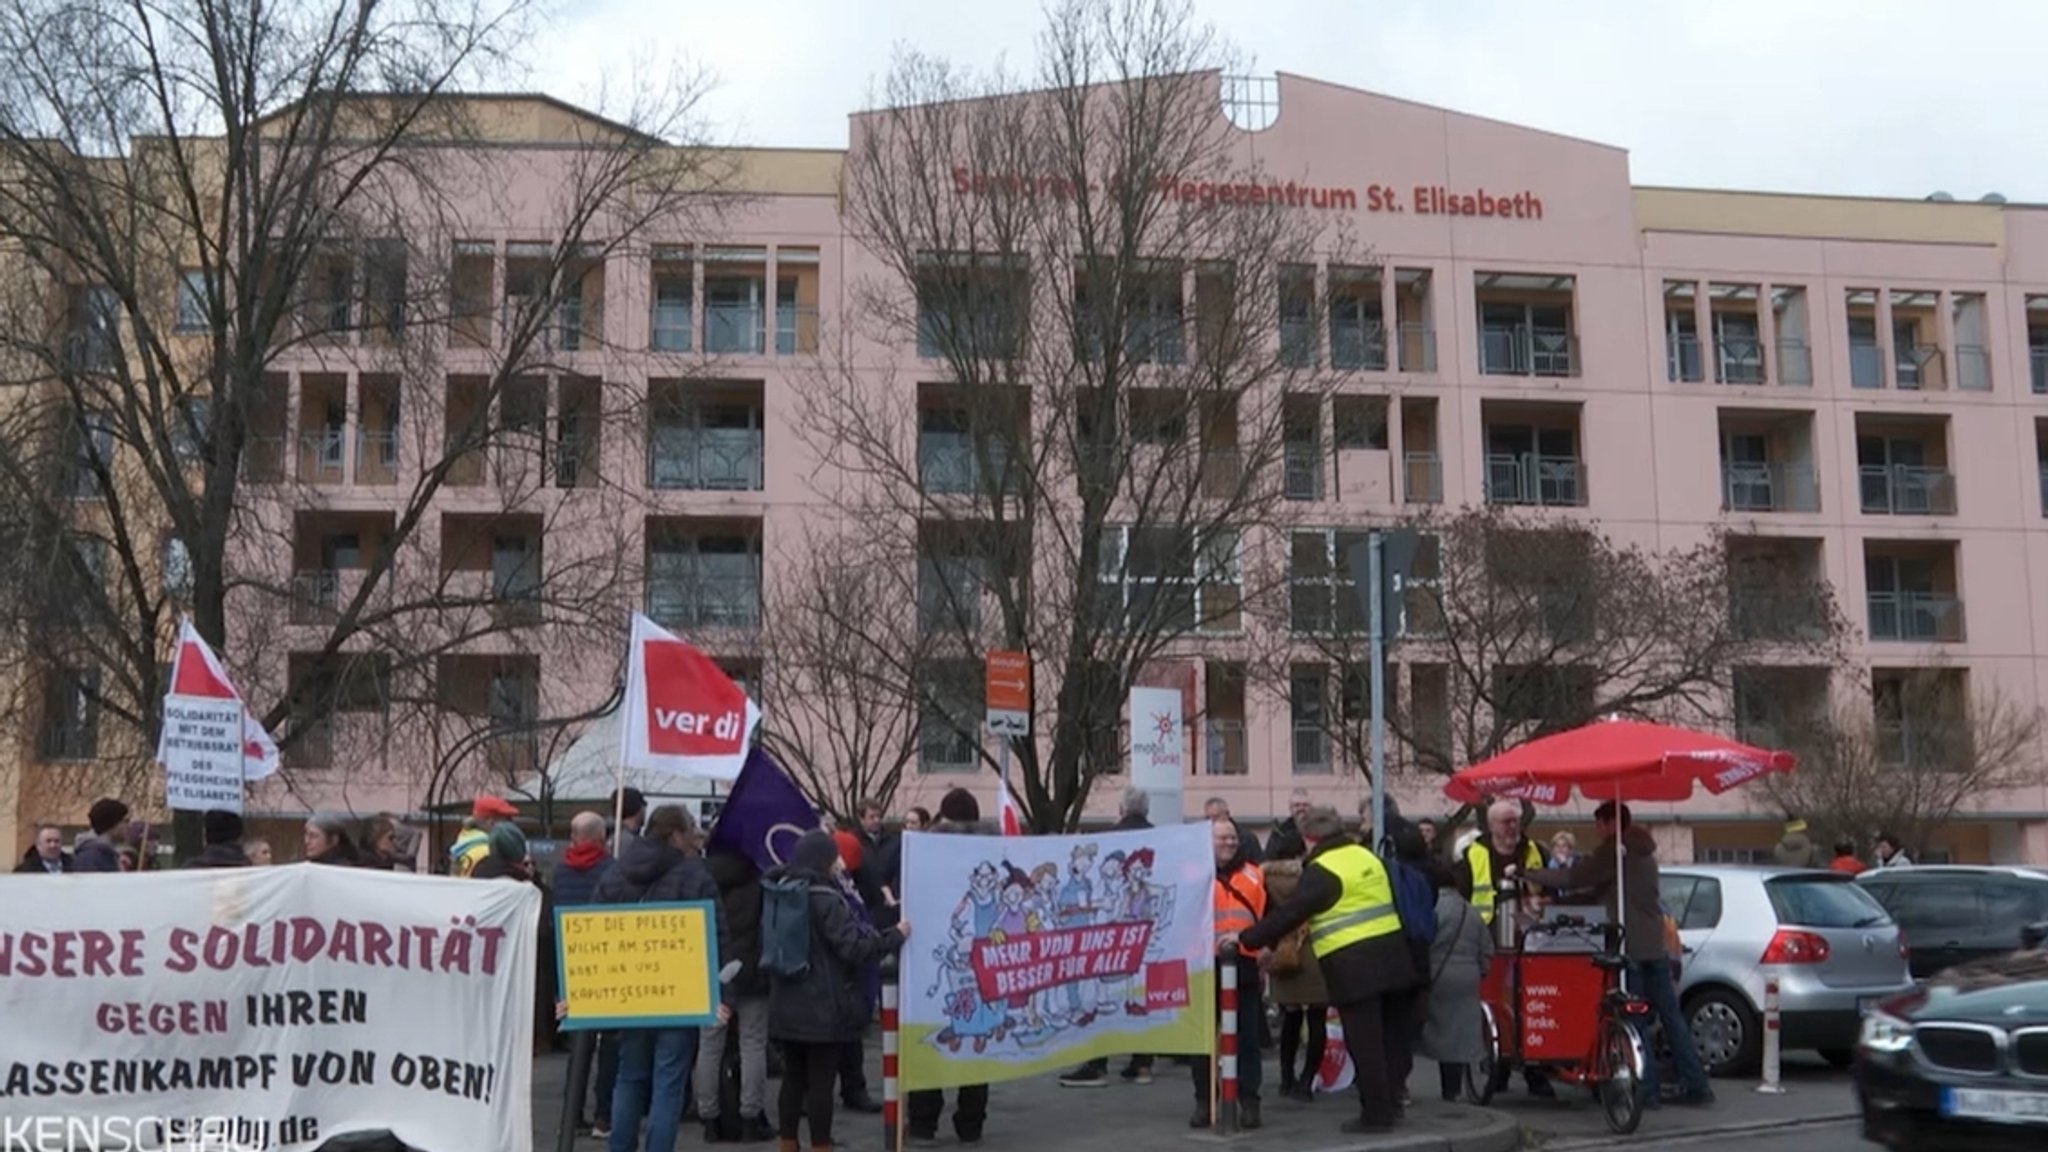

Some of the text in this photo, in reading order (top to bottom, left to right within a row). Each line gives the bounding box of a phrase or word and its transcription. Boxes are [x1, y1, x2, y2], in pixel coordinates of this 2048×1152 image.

[1148, 172, 1356, 210] flegezentrum
[1367, 184, 1403, 212] St.
[1414, 186, 1542, 219] Elisabeth
[167, 708, 239, 724] SOLIDARITÄT
[179, 724, 225, 738] MIT DEM
[167, 738, 239, 752] BETRIEBSRAT
[192, 760, 212, 770] DES
[184, 788, 240, 801] ELISABETH
[566, 914, 686, 934] IST DIE PFLEGE
[166, 916, 506, 976] SOLIDARITÄT
[567, 941, 608, 955] NICHT
[618, 939, 637, 953] AM
[981, 924, 1148, 969] MEHR VON UNS IST
[996, 963, 1053, 995] BESSER
[1092, 950, 1130, 972] ALLE
[1526, 984, 1561, 997] www.
[97, 990, 367, 1035] GEGEN IHREN
[1526, 1000, 1552, 1013] die-
[1526, 1016, 1559, 1031] linke.
[1526, 1033, 1543, 1046] de
[0, 1050, 495, 1105] ASSENKAMPF VON OBEN!
